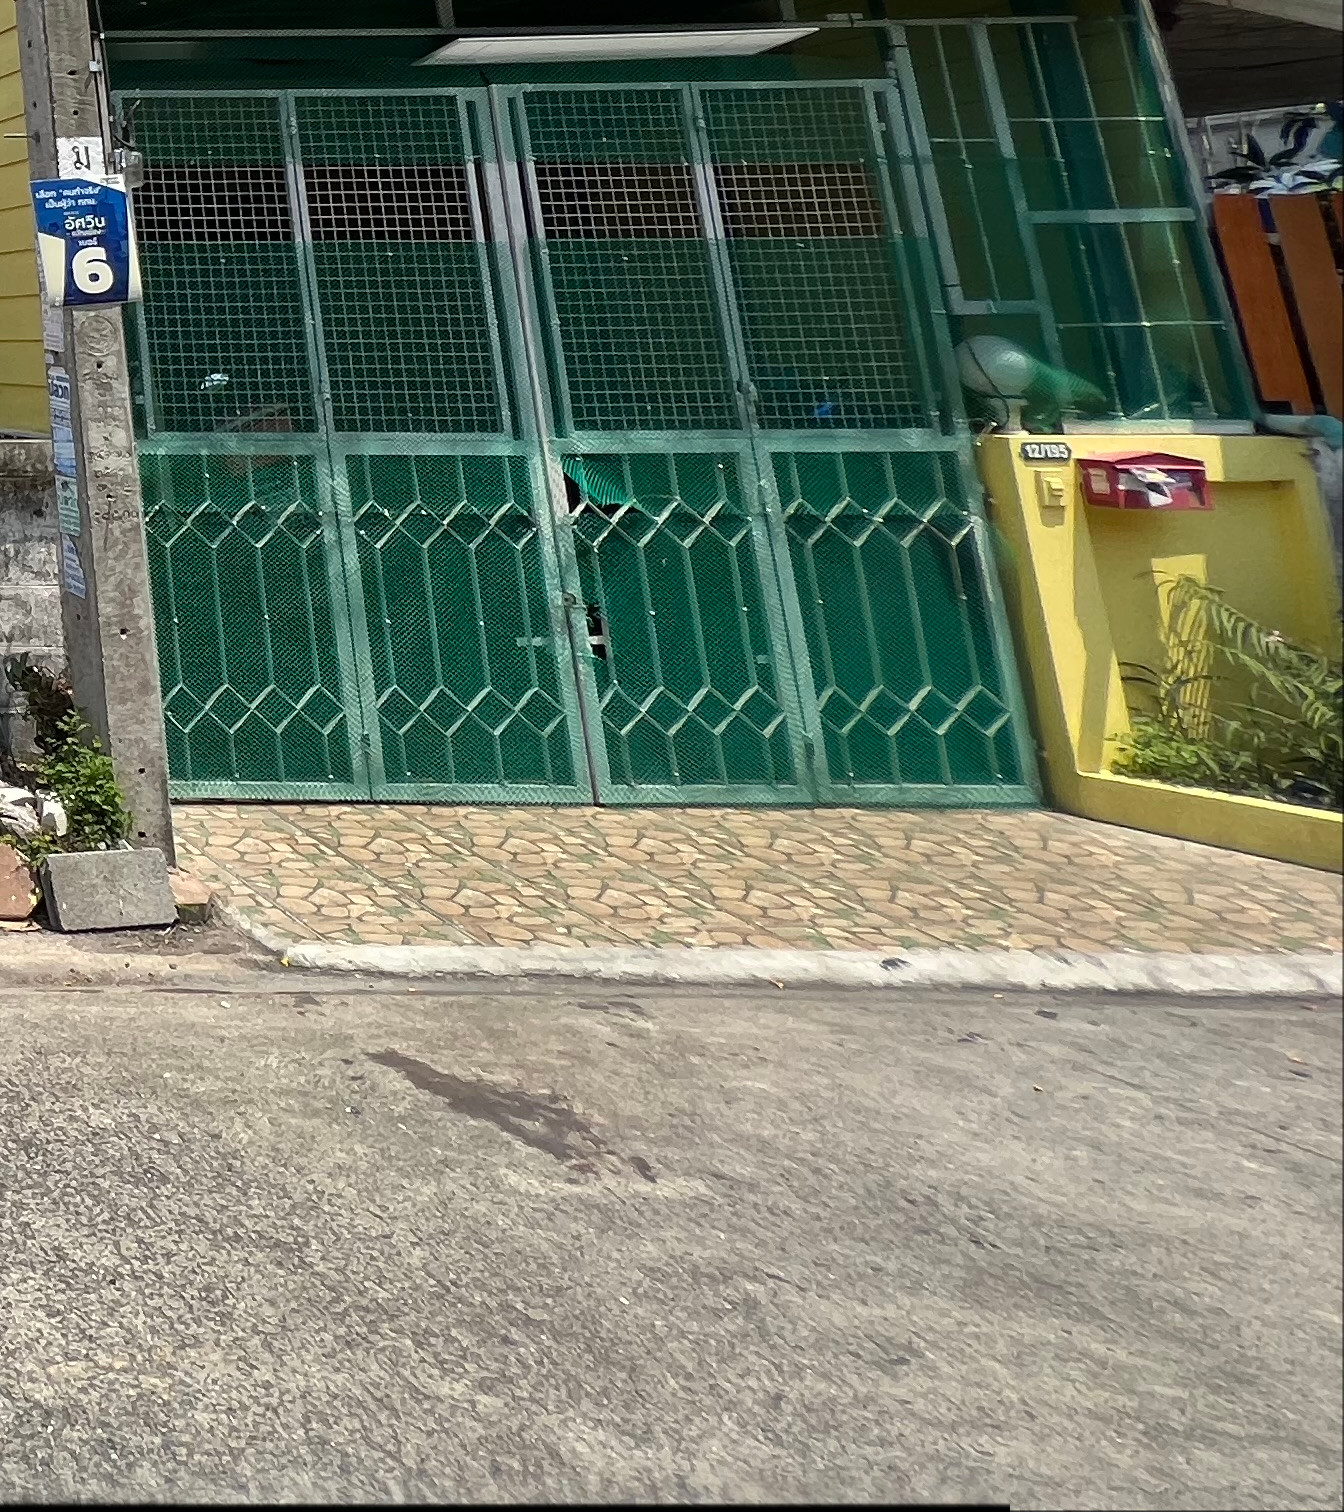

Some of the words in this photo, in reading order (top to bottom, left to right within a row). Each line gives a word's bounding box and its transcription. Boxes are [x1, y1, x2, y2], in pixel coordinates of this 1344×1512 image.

[64, 214, 106, 230] อัศวิน
[72, 246, 113, 294] 6
